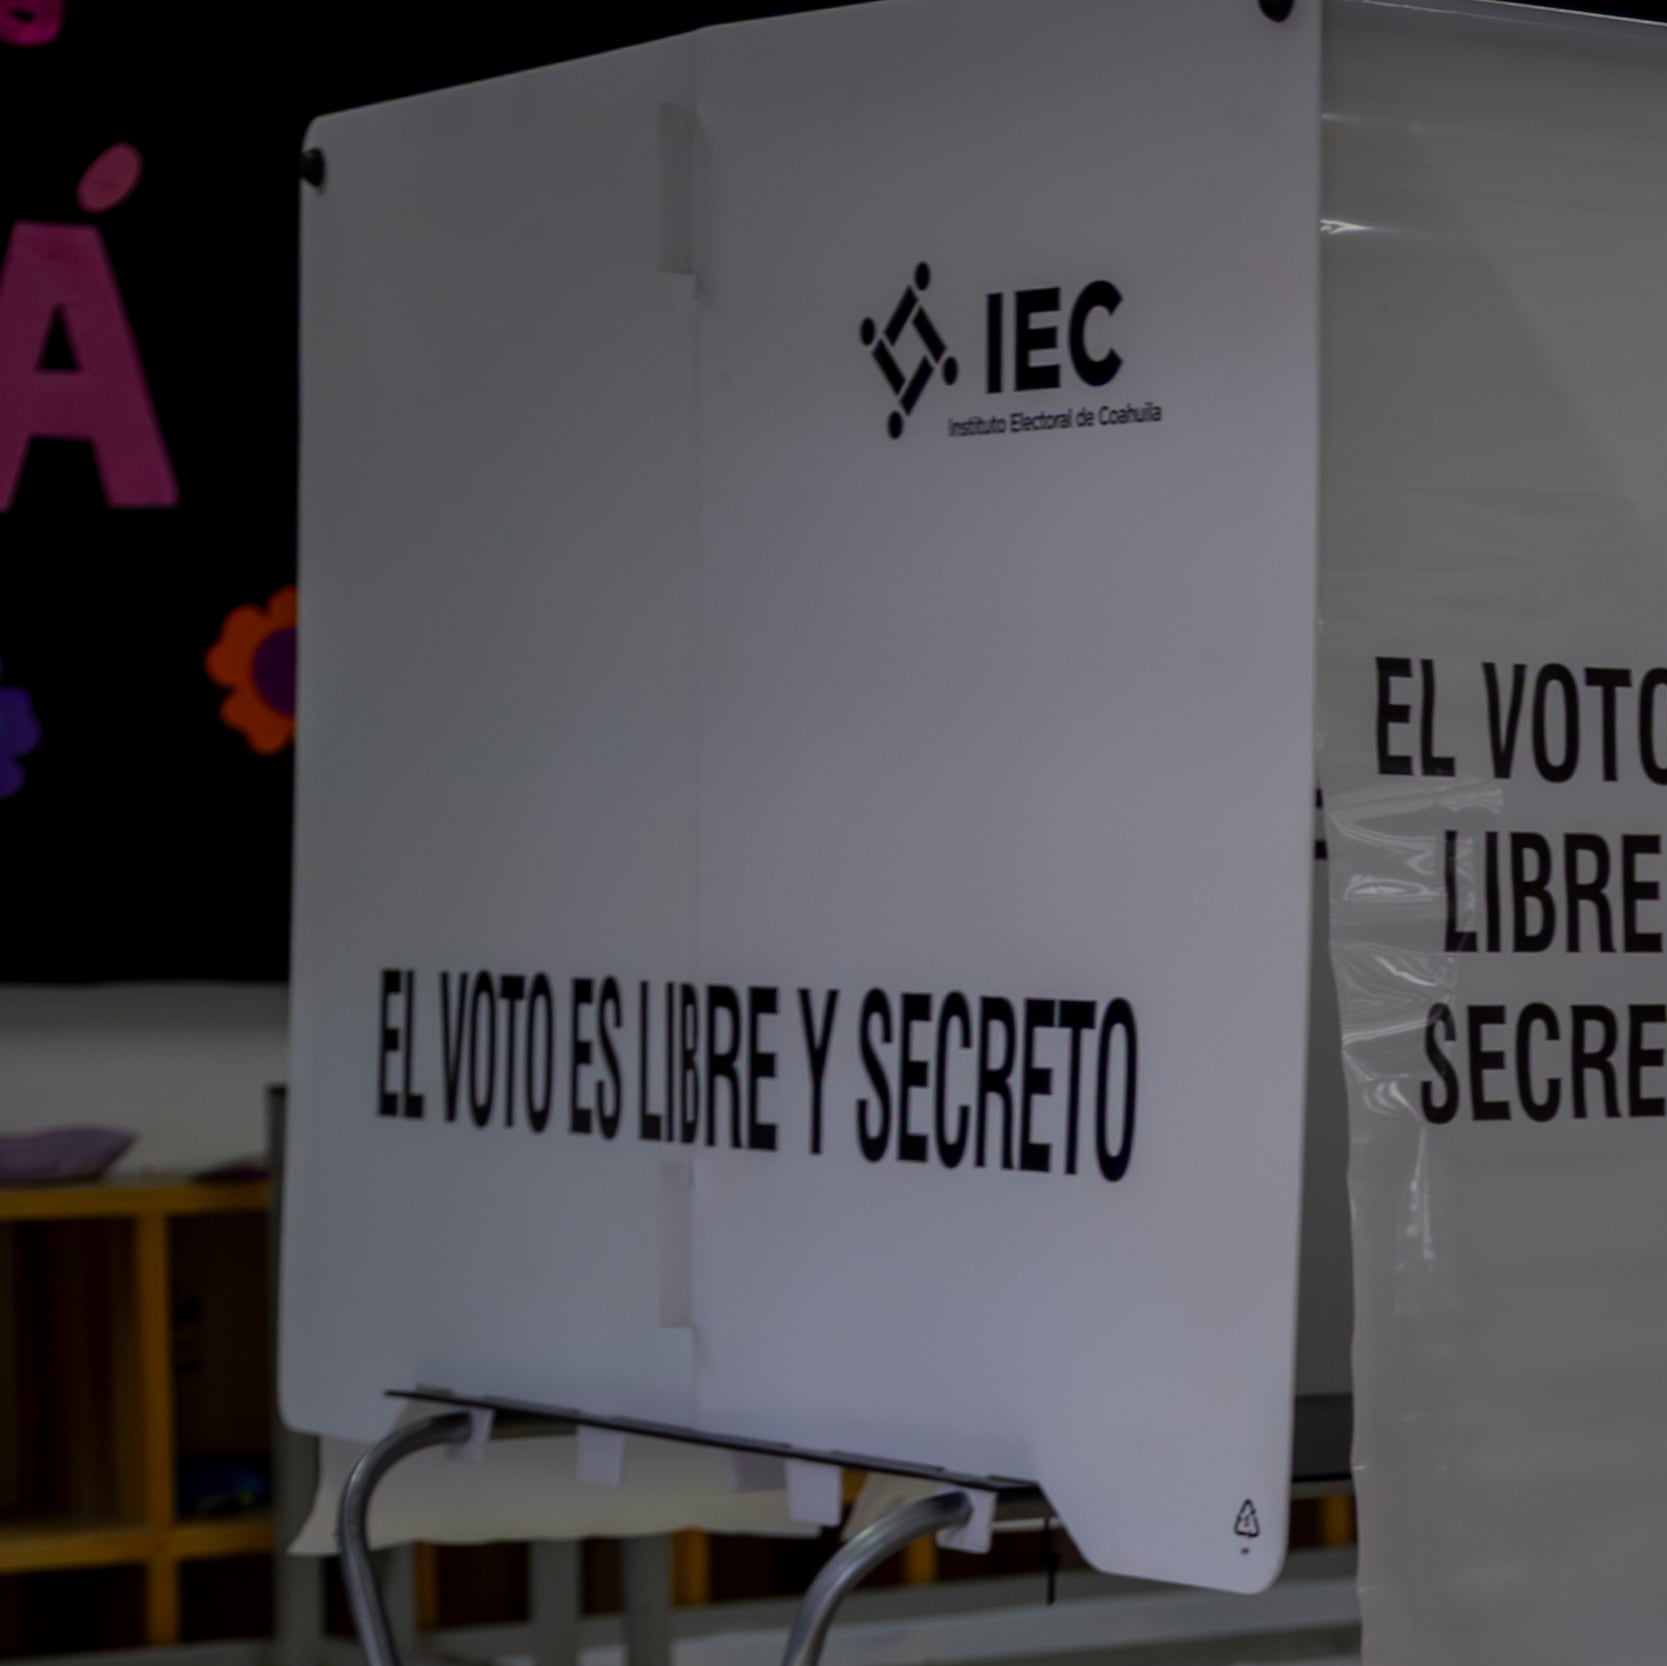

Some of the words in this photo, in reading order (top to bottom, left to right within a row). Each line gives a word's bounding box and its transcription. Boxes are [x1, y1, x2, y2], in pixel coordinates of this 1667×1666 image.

[986, 280, 1123, 394] IEC
[948, 415, 1006, 437] Instituto
[1009, 408, 1072, 433] Electoral
[1075, 407, 1095, 428] de
[1098, 402, 1162, 426] Coahuila
[1375, 656, 1455, 778] EL
[1444, 829, 1664, 953] LIBRE
[376, 969, 425, 1118] EL
[439, 971, 555, 1132] VOTO
[569, 977, 623, 1139] ES
[640, 981, 779, 1151] LIBRE
[798, 988, 840, 1154] Y
[857, 987, 1138, 1182] SECRETO
